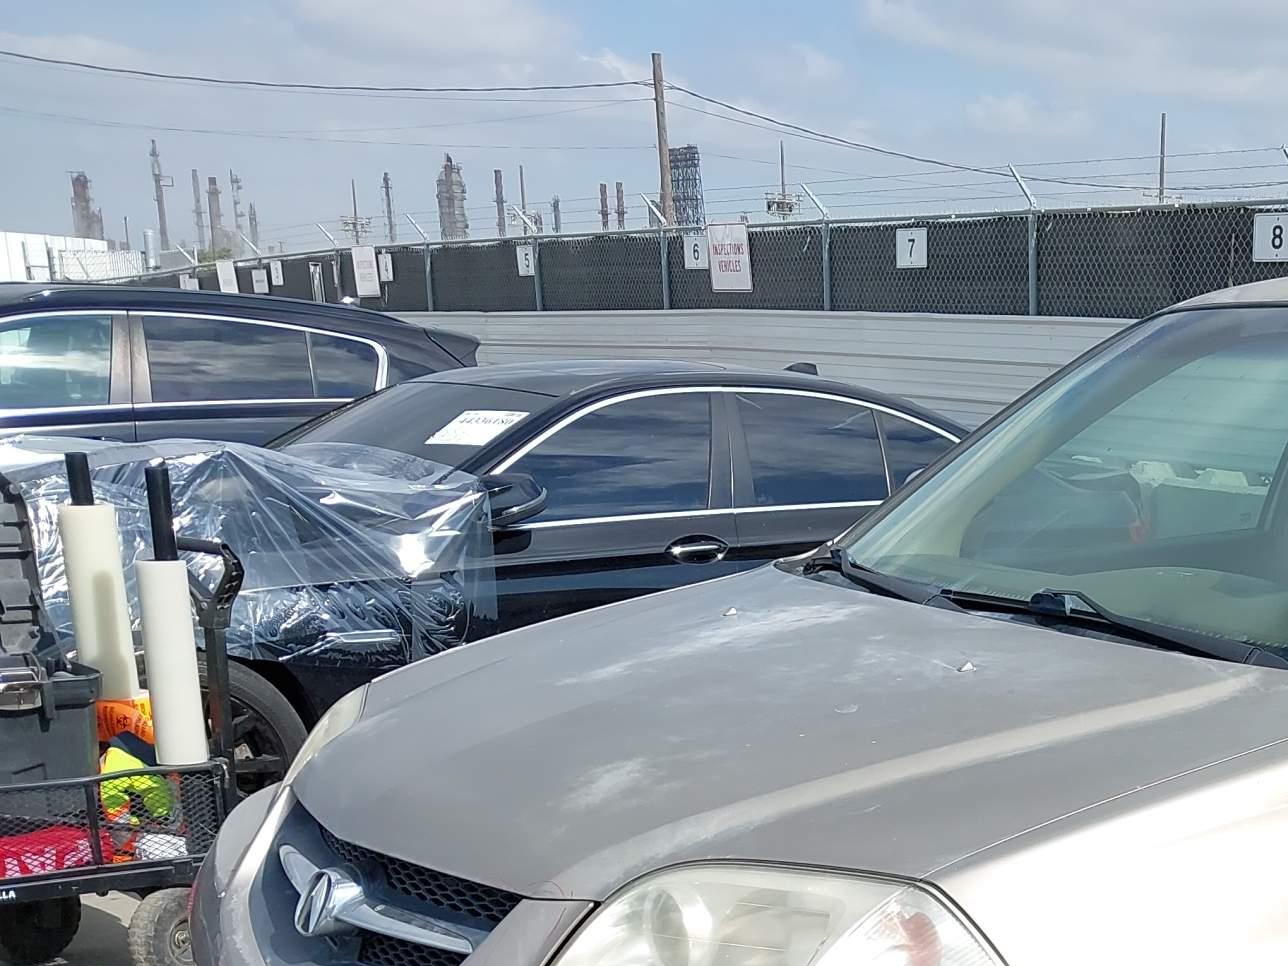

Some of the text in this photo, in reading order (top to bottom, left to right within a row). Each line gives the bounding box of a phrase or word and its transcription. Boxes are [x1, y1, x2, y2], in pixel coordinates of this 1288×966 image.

[1271, 225, 1284, 250] 8
[692, 243, 700, 261] 6
[712, 243, 745, 256] INSPECTIONS
[907, 238, 916, 259] 7
[524, 253, 531, 269] 5
[718, 260, 742, 273] VEHICLES
